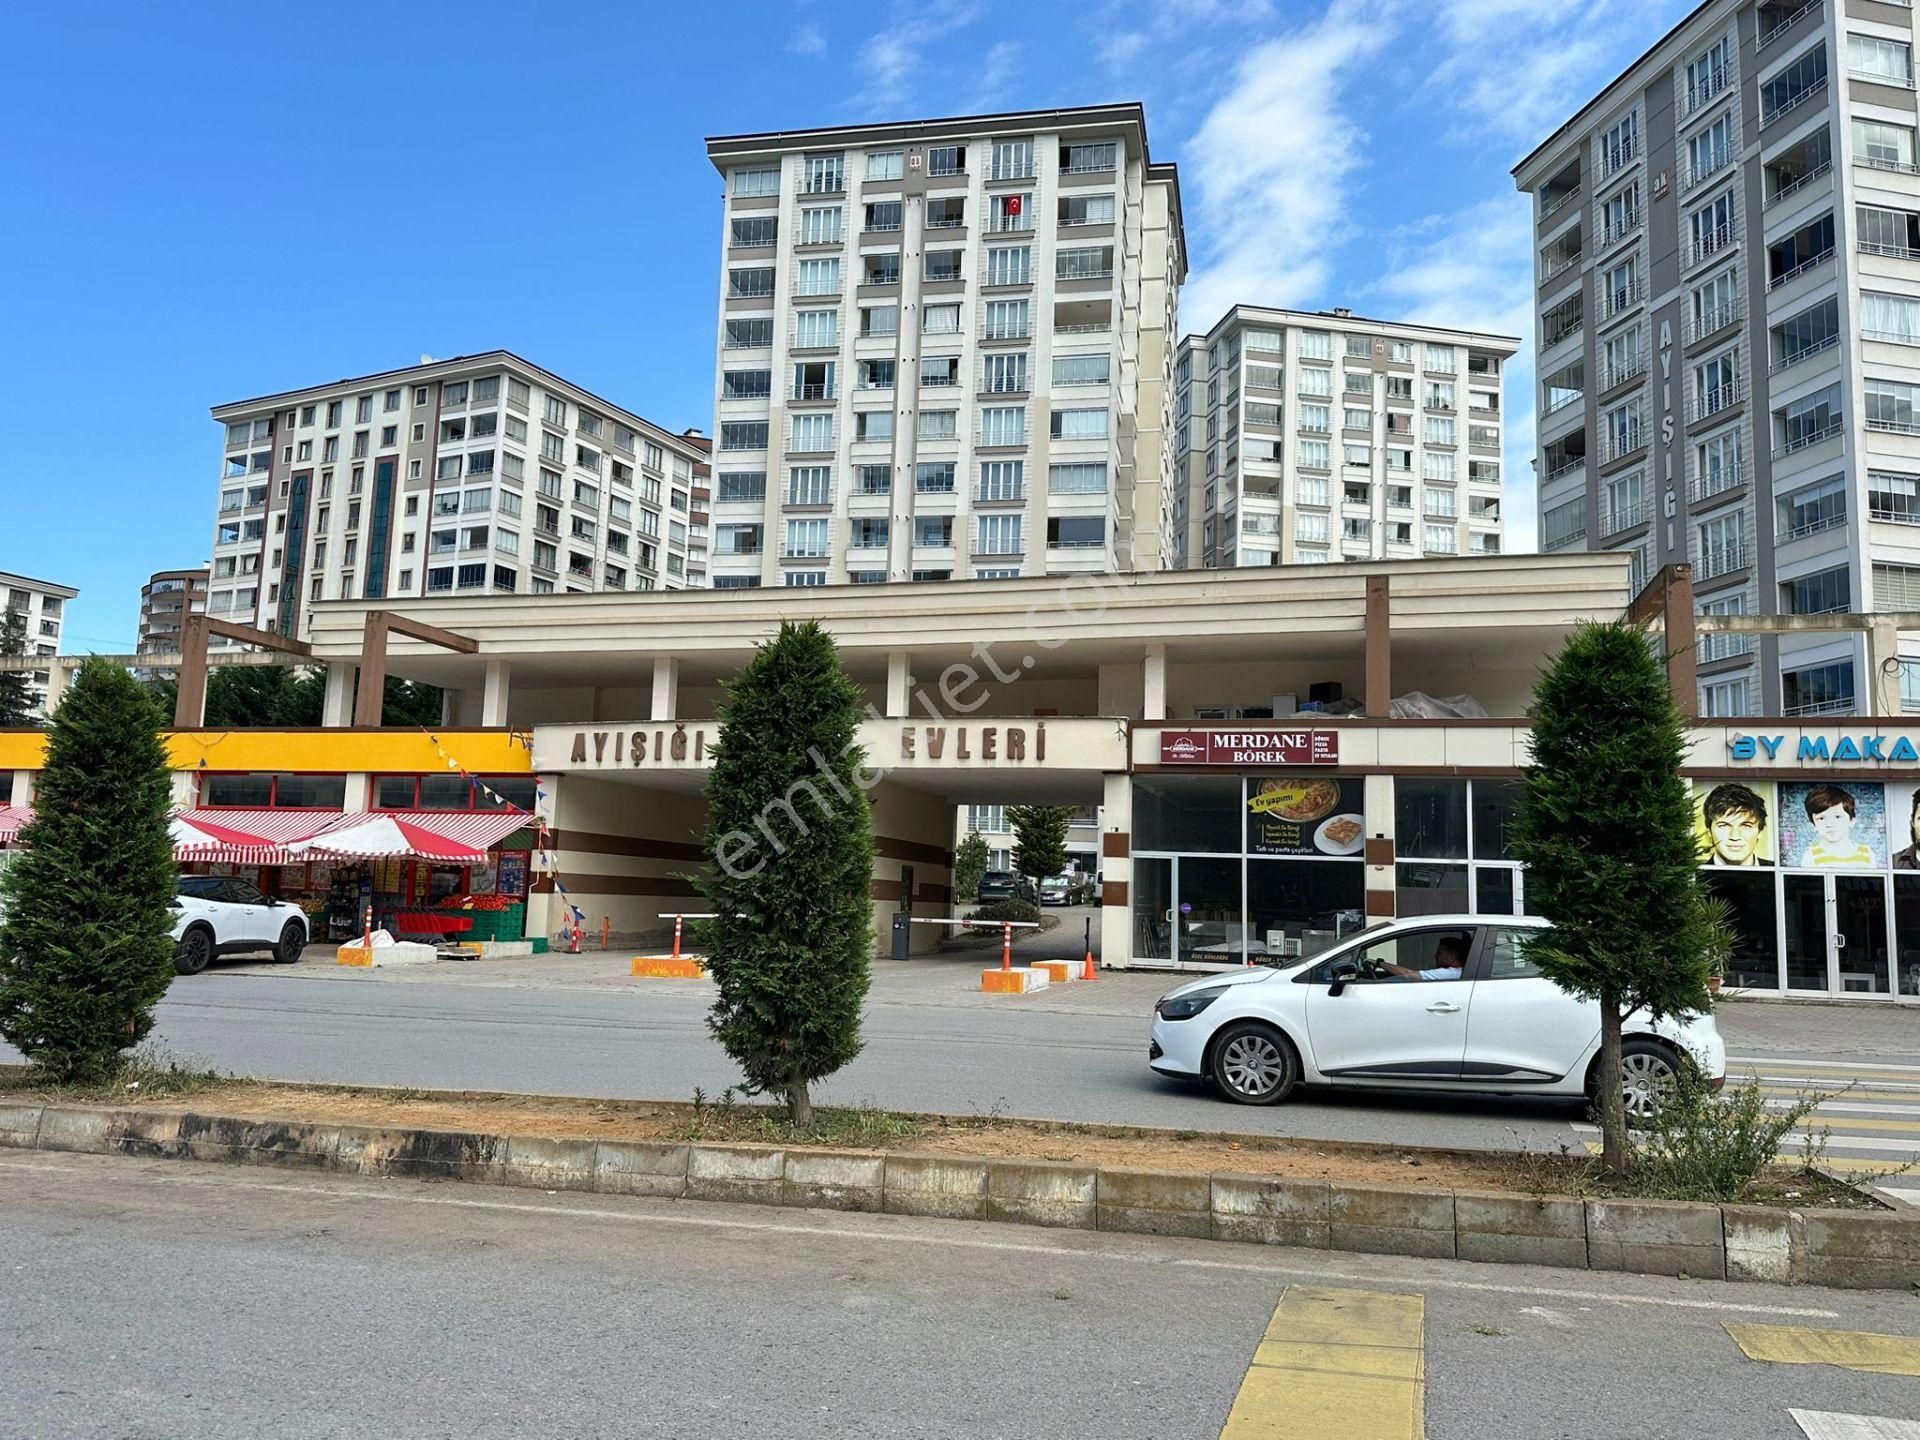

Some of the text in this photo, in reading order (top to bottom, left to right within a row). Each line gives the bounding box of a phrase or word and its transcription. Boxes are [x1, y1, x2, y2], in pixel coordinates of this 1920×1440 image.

[1659, 319, 1677, 552] AYIŞIĞI
[571, 721, 1046, 767] AYIŞIĞI EVLERİ
[1214, 734, 1307, 748] MERDANE
[1732, 735, 1920, 761] BY MAKA
[1233, 749, 1286, 762] BÖREK
[1255, 794, 1293, 806] Ev yapımı
